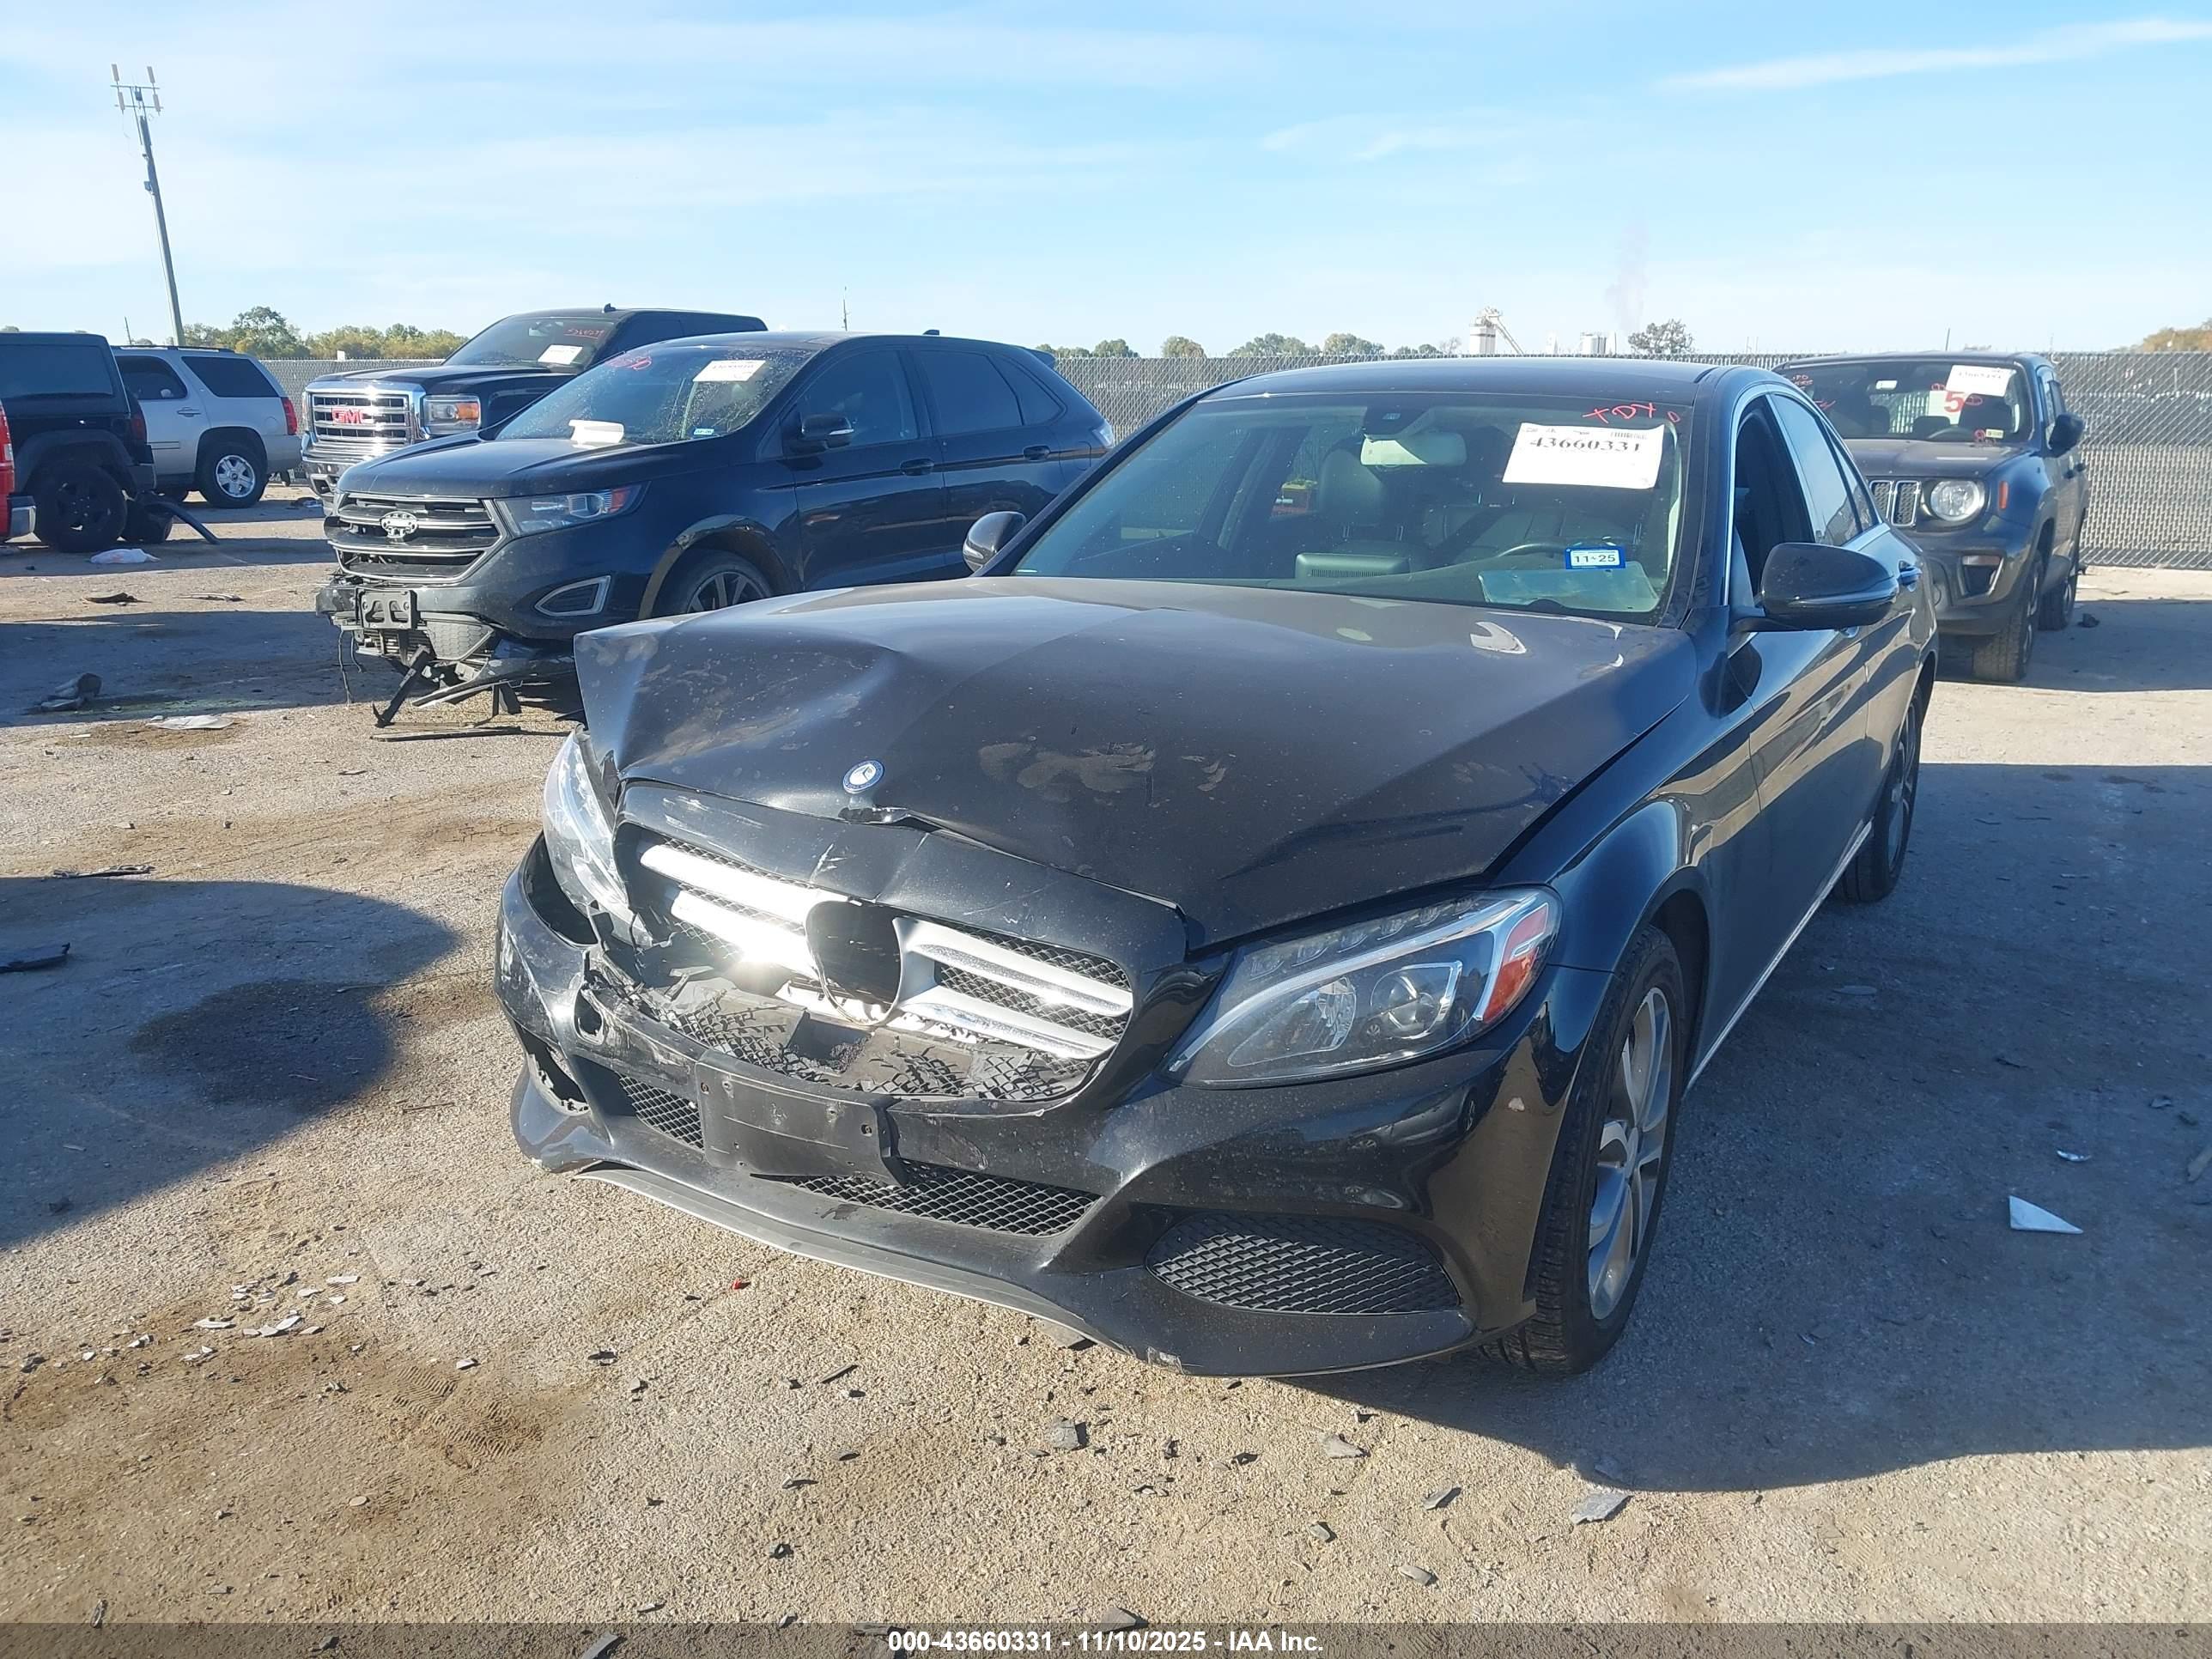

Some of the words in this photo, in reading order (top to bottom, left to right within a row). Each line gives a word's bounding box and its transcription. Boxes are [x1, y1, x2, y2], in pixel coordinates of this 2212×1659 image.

[1944, 392, 1965, 412] 5
[331, 407, 373, 424] GMC
[1529, 436, 1641, 452] 43660331
